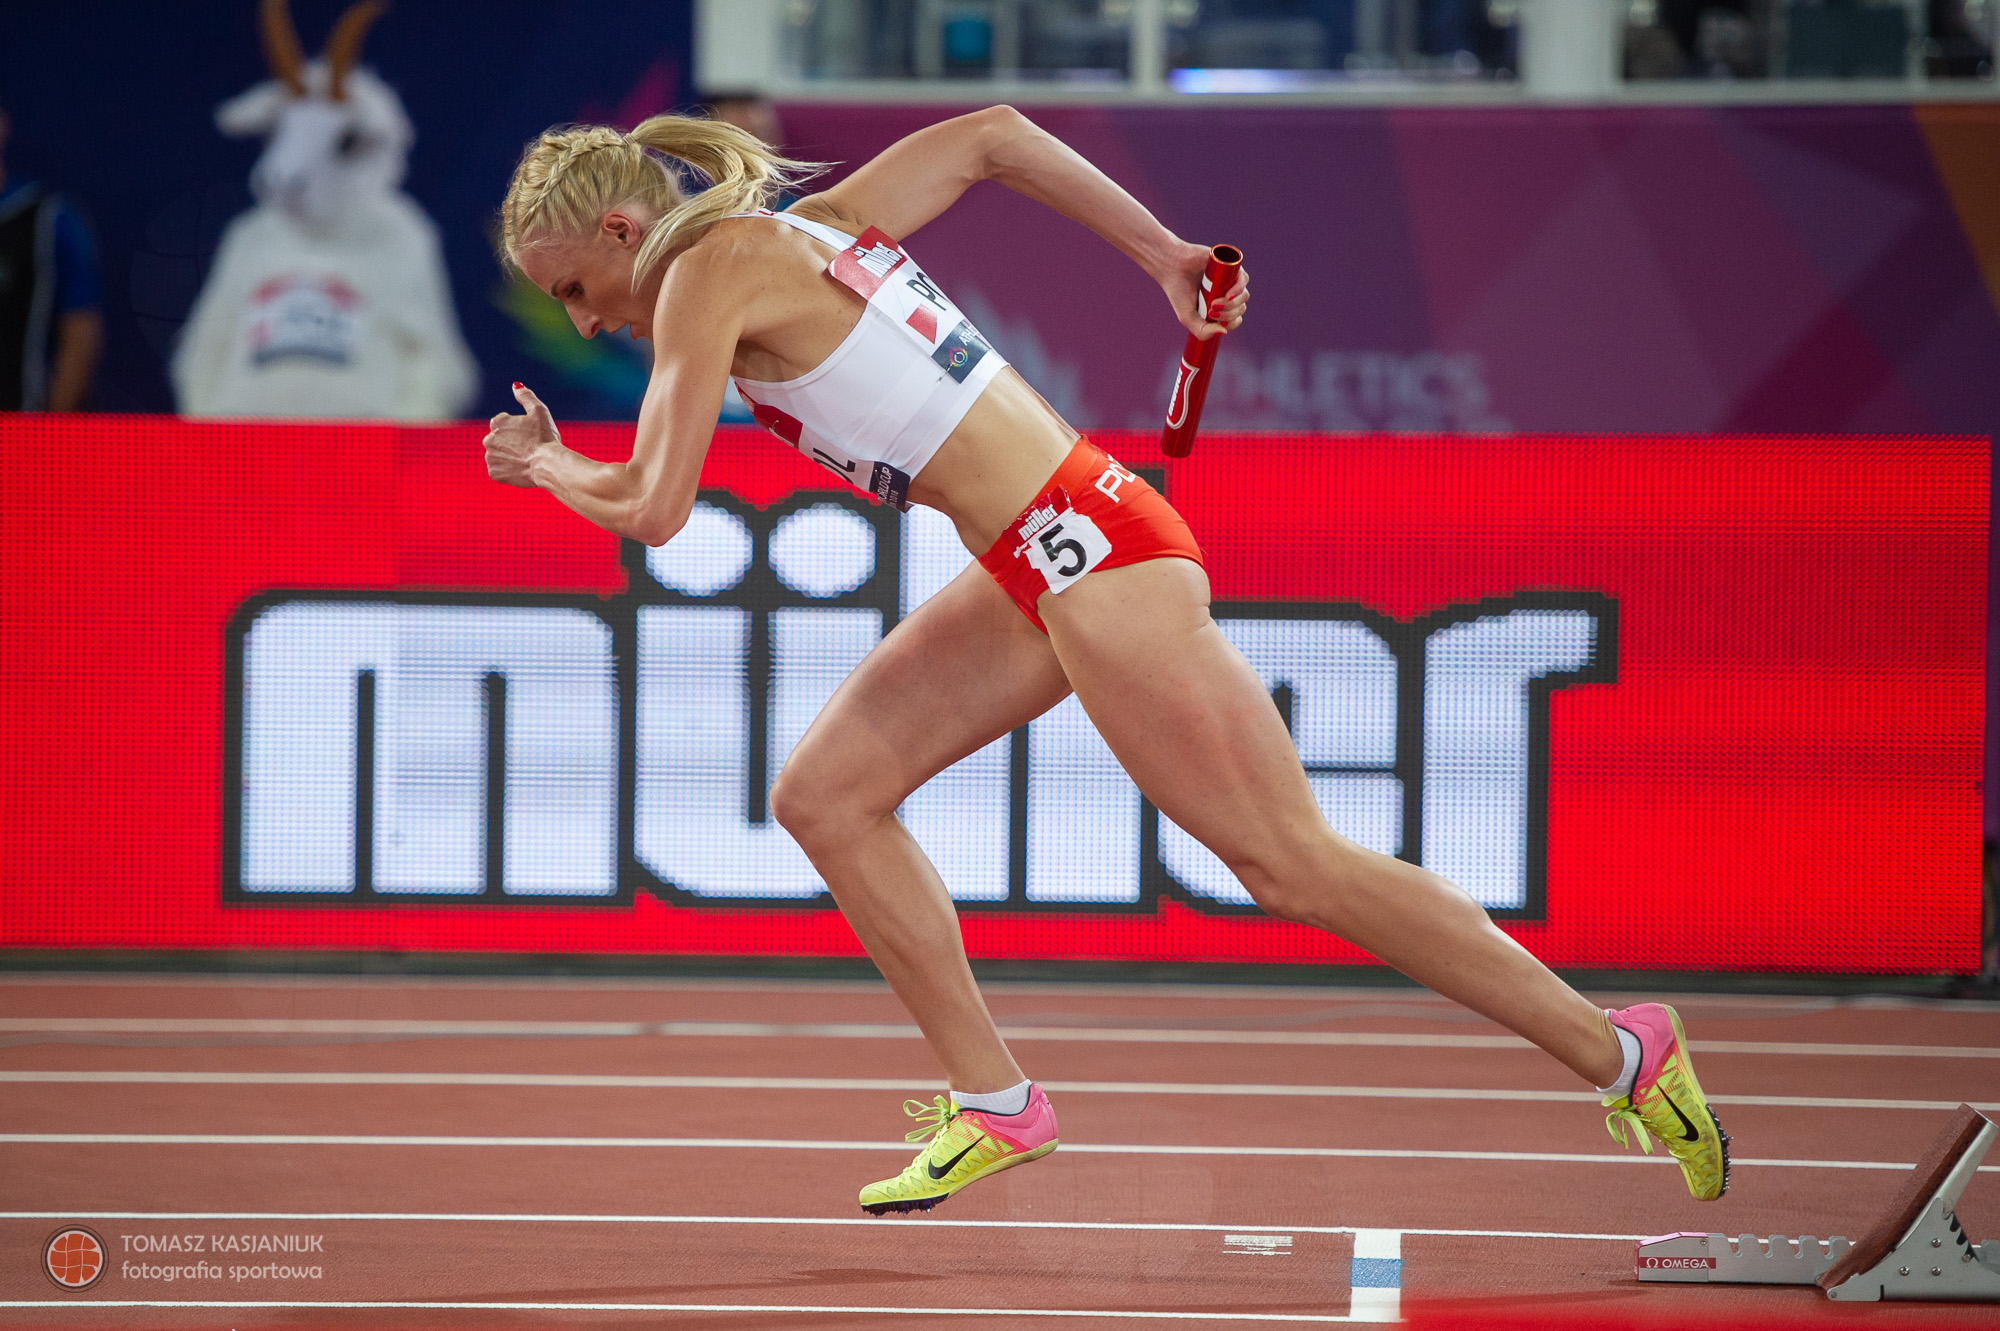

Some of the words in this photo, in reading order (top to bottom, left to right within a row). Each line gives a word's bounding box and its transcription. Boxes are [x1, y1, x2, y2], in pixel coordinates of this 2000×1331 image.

[1157, 349, 1490, 412] THLETICS
[880, 466, 892, 483] CUP
[1018, 503, 1059, 541] müller
[1038, 522, 1088, 578] 5
[239, 488, 1599, 910] müer
[1662, 1258, 1709, 1269] OMEGA
